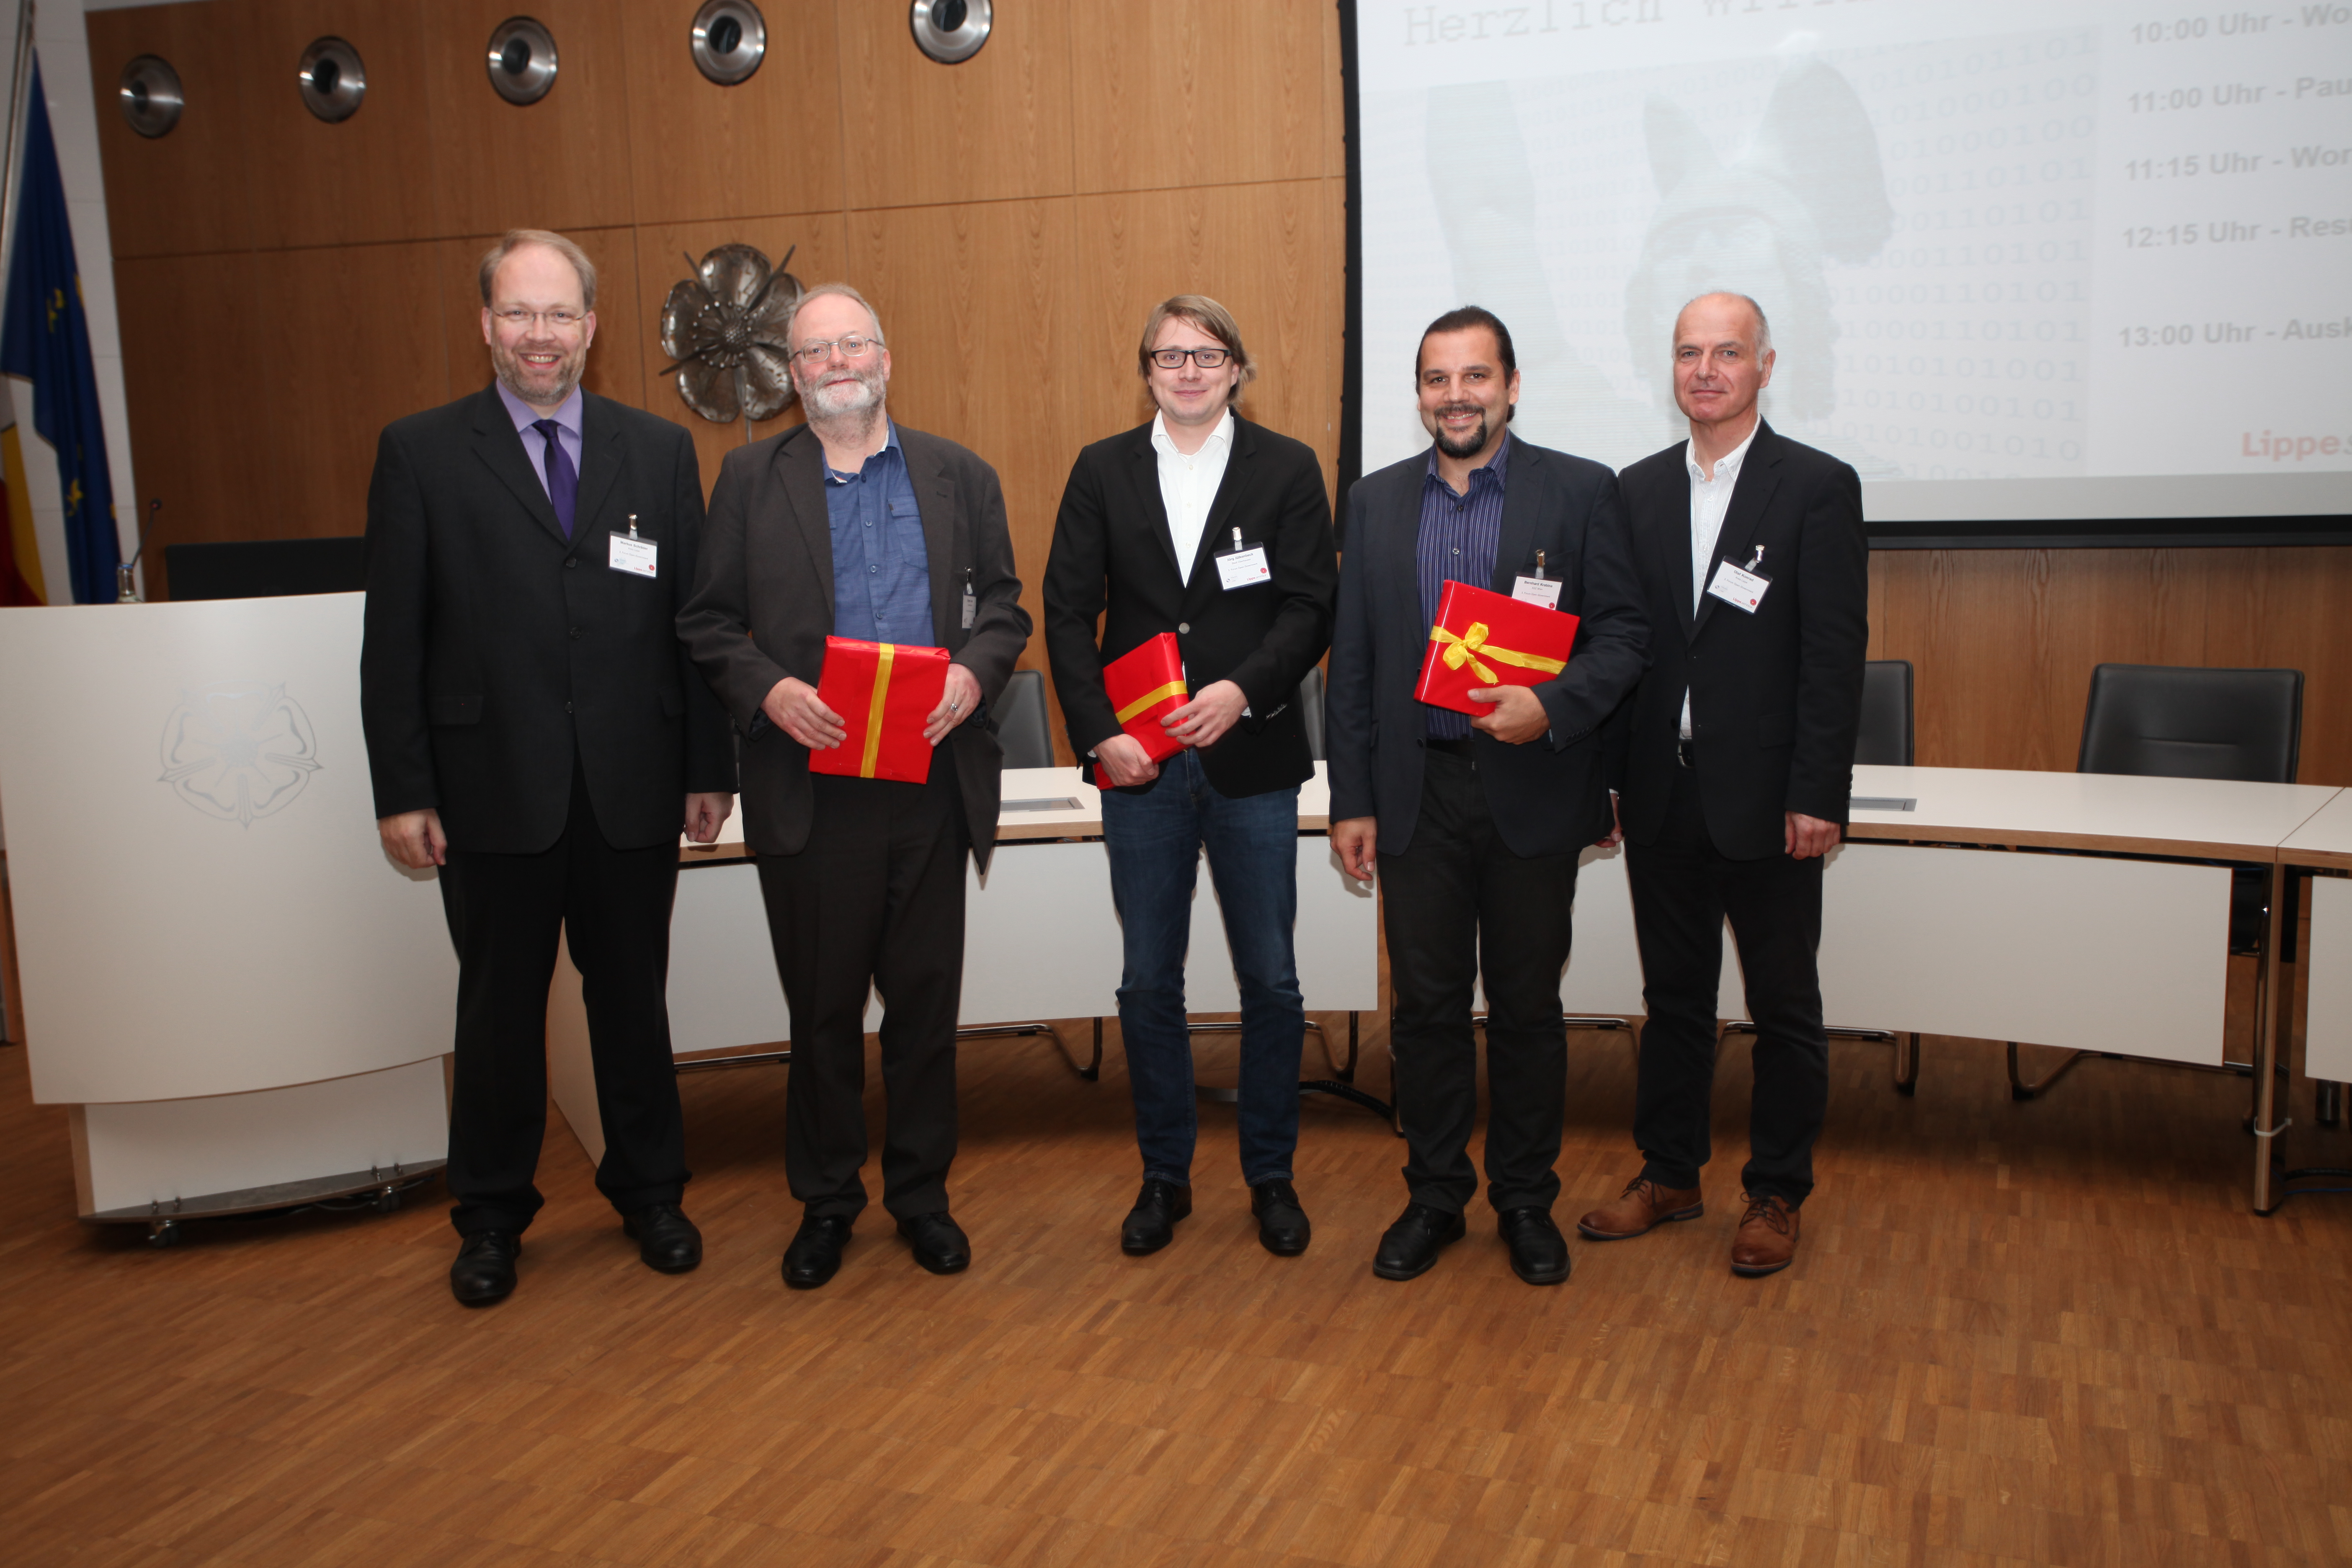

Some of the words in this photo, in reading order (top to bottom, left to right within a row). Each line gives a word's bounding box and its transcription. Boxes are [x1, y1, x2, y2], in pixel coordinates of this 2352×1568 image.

[2131, 17, 2208, 45] 10:00
[2219, 12, 2273, 36] Uhr
[2128, 87, 2202, 113] 11:00
[2213, 83, 2267, 106] Uhr
[2295, 76, 2352, 99] Pau
[2125, 154, 2200, 181] 11:15
[2210, 151, 2263, 174] Uhr
[2290, 144, 2352, 168] Wor
[2123, 223, 2198, 248] 12:15
[2209, 220, 2262, 243] Uhr
[2290, 216, 2352, 239] Res
[2119, 324, 2194, 347] 13:00
[2204, 322, 2257, 343] Uhr
